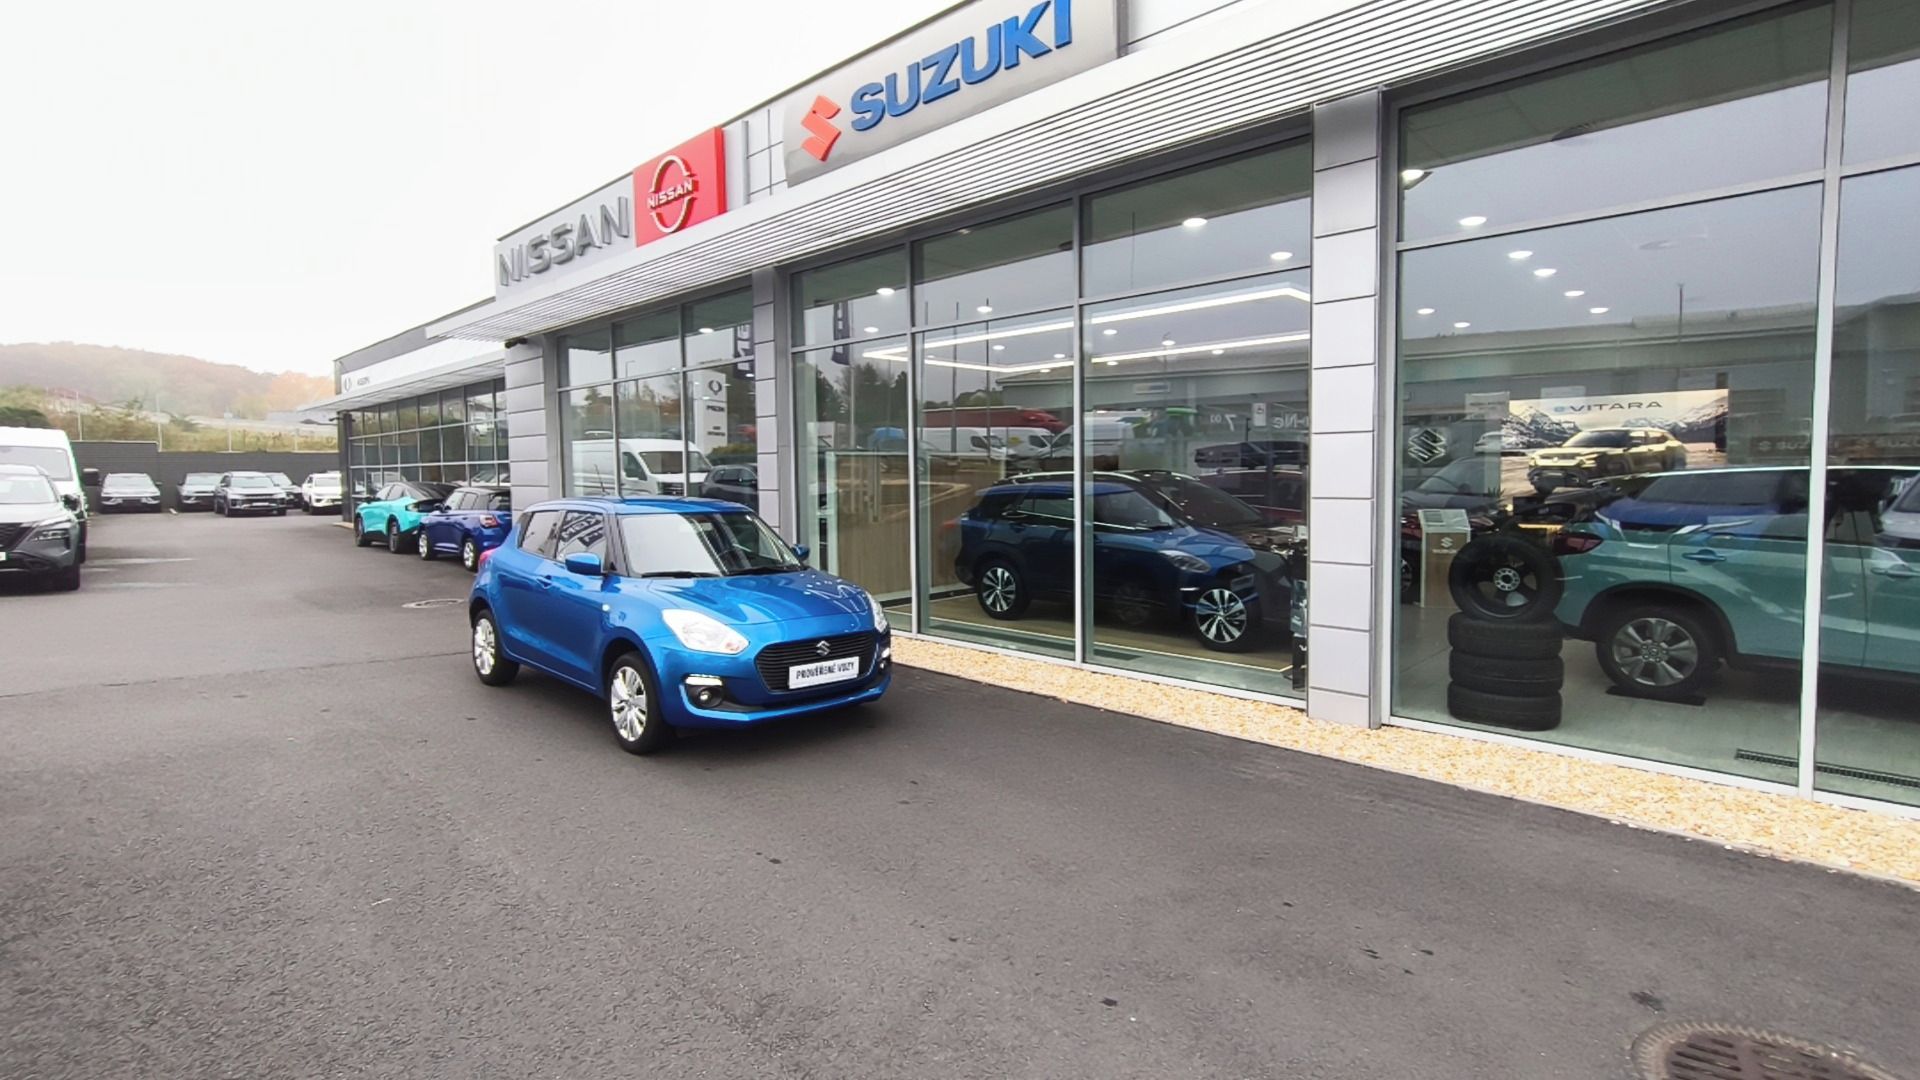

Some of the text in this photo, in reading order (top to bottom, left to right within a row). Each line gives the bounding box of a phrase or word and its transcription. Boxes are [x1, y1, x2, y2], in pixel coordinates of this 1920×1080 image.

[850, 0, 1073, 132] SUZUKI
[647, 179, 693, 208] NISSAN
[500, 196, 630, 276] NISSAN
